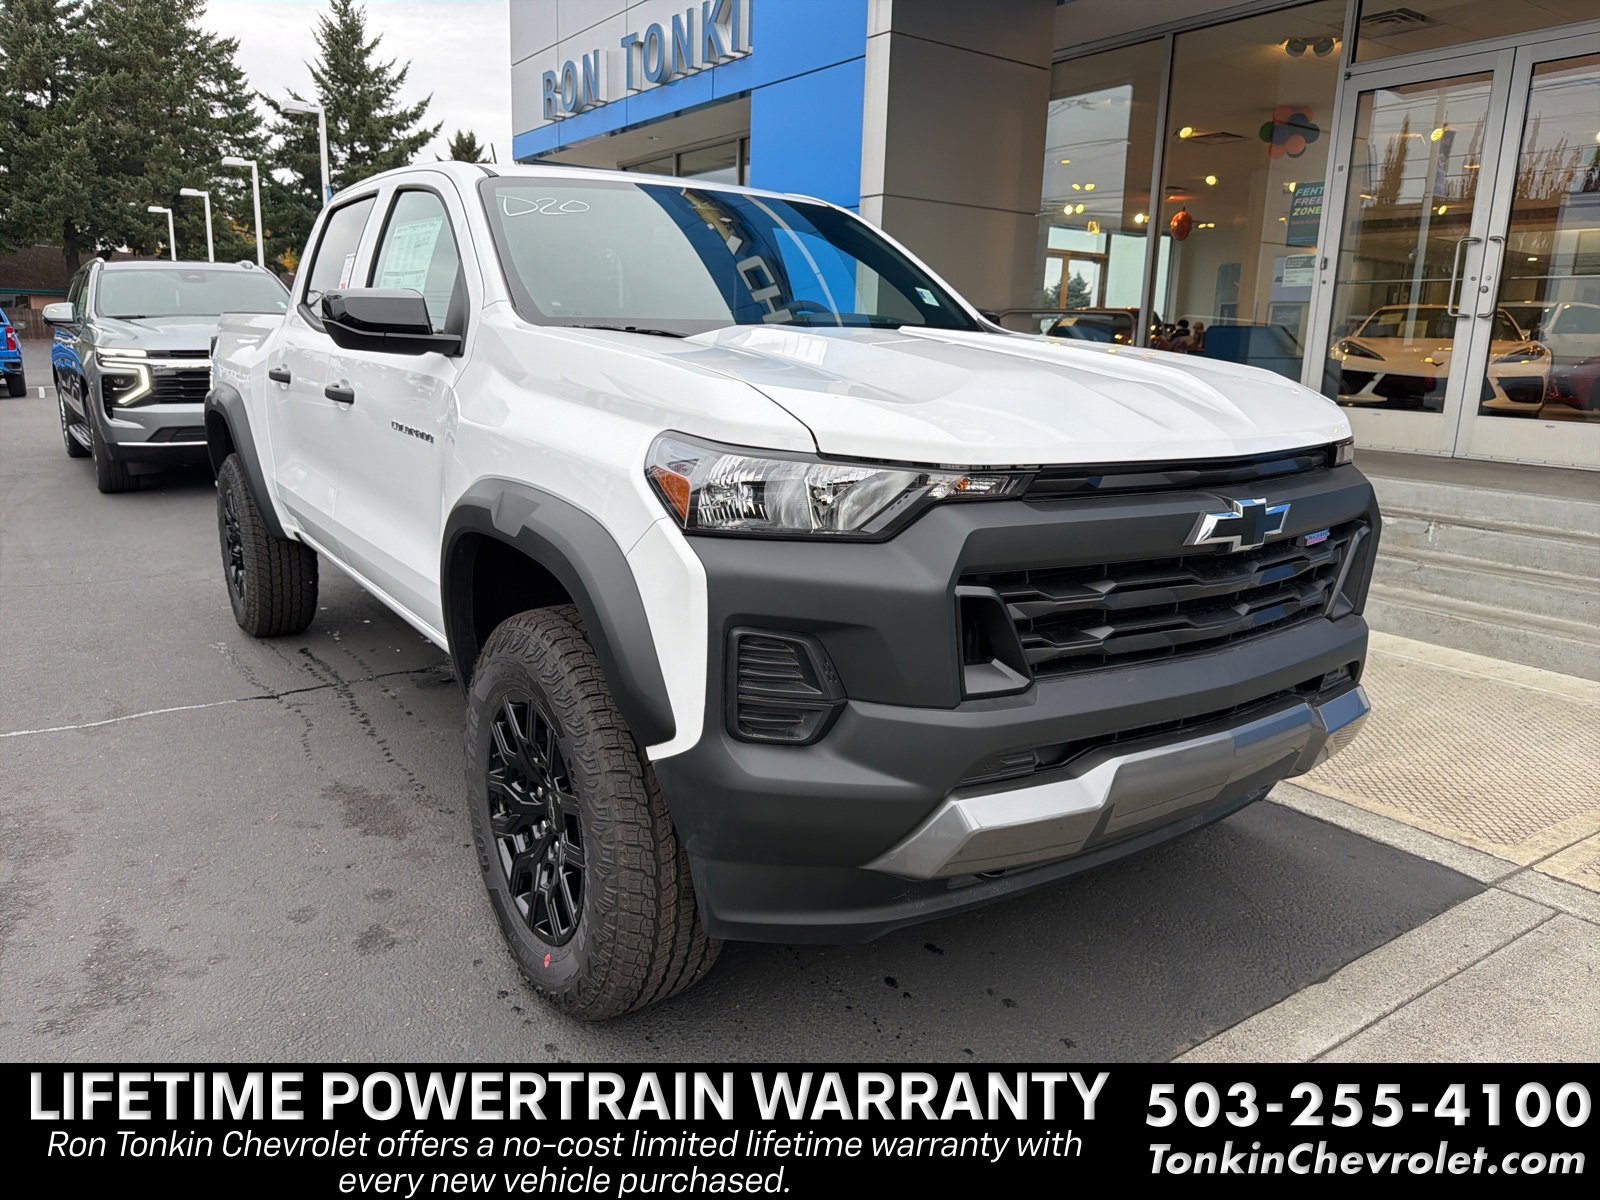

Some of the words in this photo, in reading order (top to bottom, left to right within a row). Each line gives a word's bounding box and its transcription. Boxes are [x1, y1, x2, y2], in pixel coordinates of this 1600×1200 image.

[542, 49, 608, 121] RON
[620, 0, 754, 92] TONKI
[1294, 186, 1325, 197] FENT
[496, 194, 590, 217] D20
[1293, 196, 1323, 207] FREE
[1292, 205, 1323, 217] ZONE
